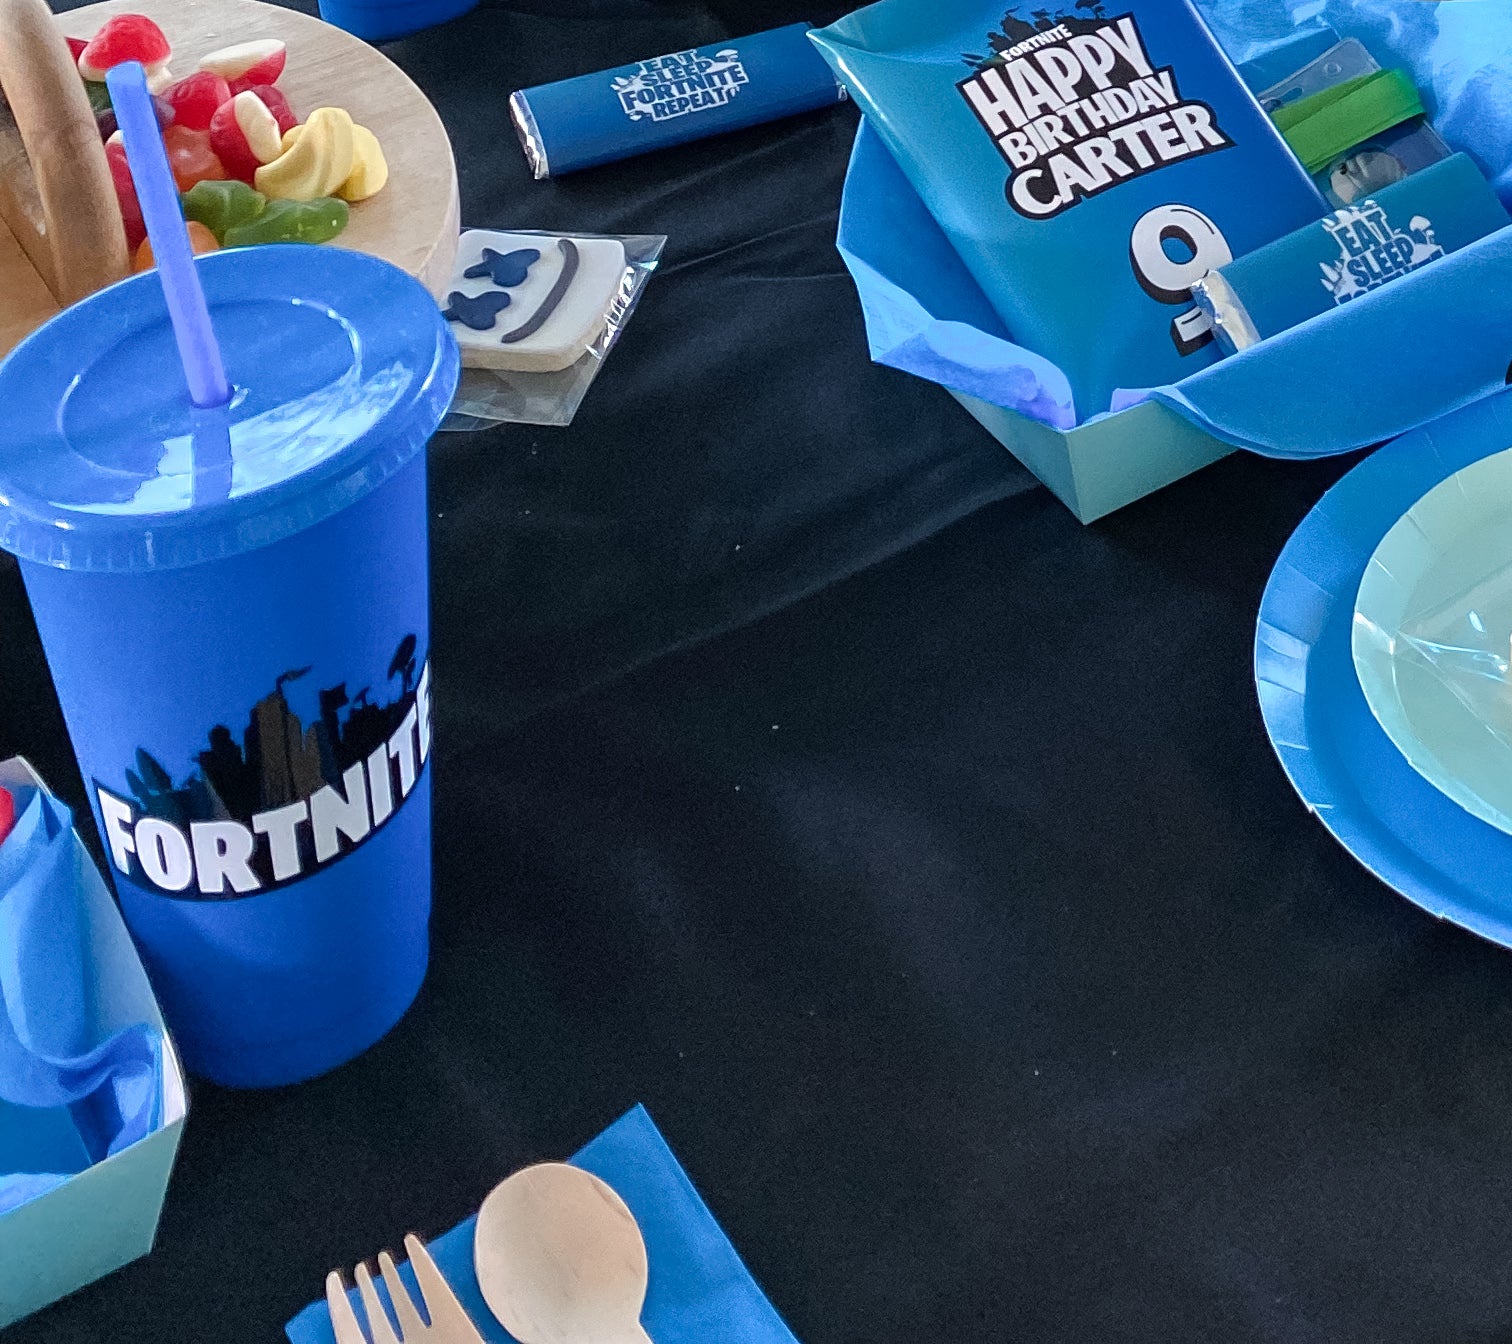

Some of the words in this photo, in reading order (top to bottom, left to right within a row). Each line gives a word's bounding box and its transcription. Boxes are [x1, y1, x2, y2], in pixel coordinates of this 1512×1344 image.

[641, 51, 697, 73] EAT
[999, 23, 1073, 62] FORTNITE
[621, 64, 746, 111] FORTNITE
[641, 60, 712, 86] SLEEP
[962, 16, 1154, 137] HAPPY
[652, 88, 726, 118] REPEAT
[998, 70, 1180, 169] BIRTHDAY
[1011, 104, 1226, 215] CARTER
[1334, 210, 1393, 257] EAT
[1130, 203, 1235, 355] 9
[1347, 236, 1415, 288] SLEEP
[97, 661, 431, 893] FORTNITE
